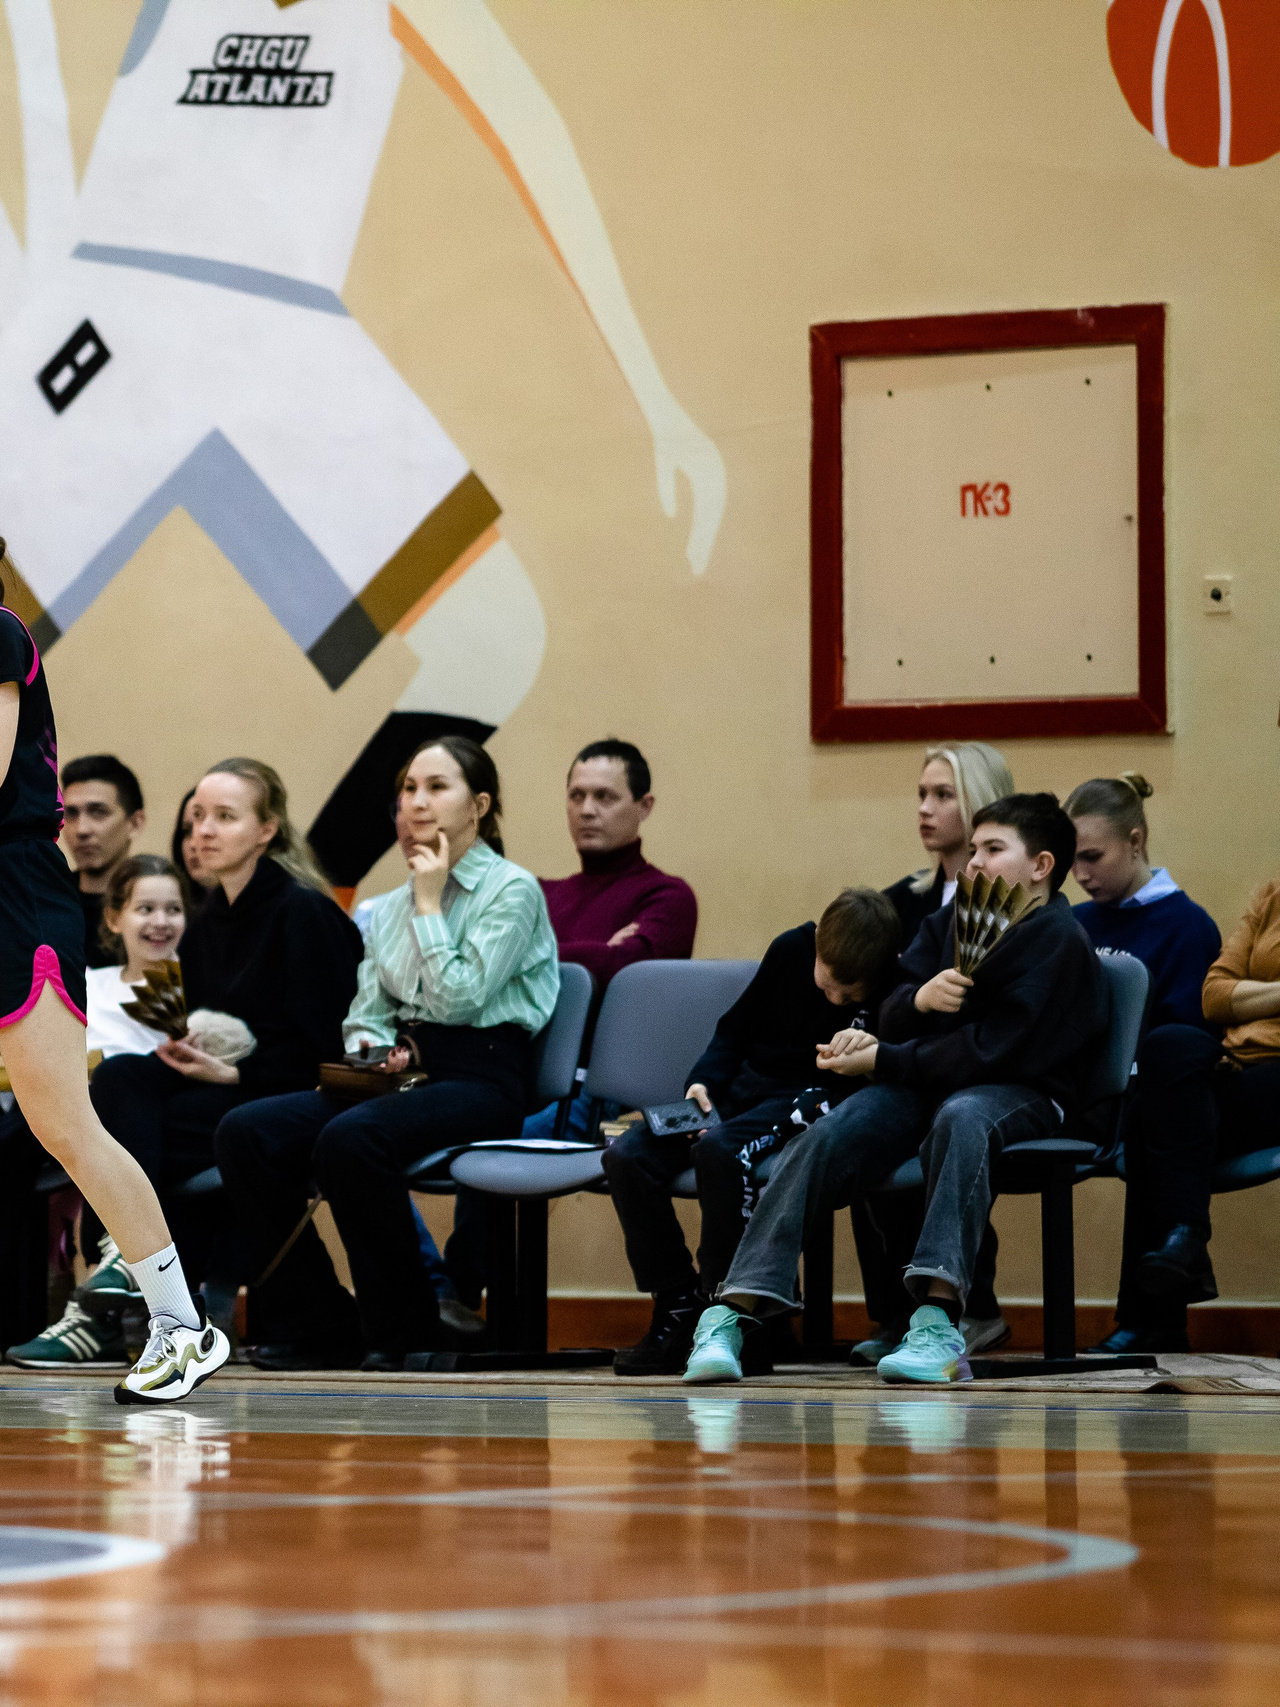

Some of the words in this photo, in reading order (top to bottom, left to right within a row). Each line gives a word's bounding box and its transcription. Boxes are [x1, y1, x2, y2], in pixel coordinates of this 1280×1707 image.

[215, 35, 308, 70] CHGU
[183, 72, 331, 104] ATLANTA
[35, 318, 111, 415] 8
[960, 482, 1010, 518] ПК-3
